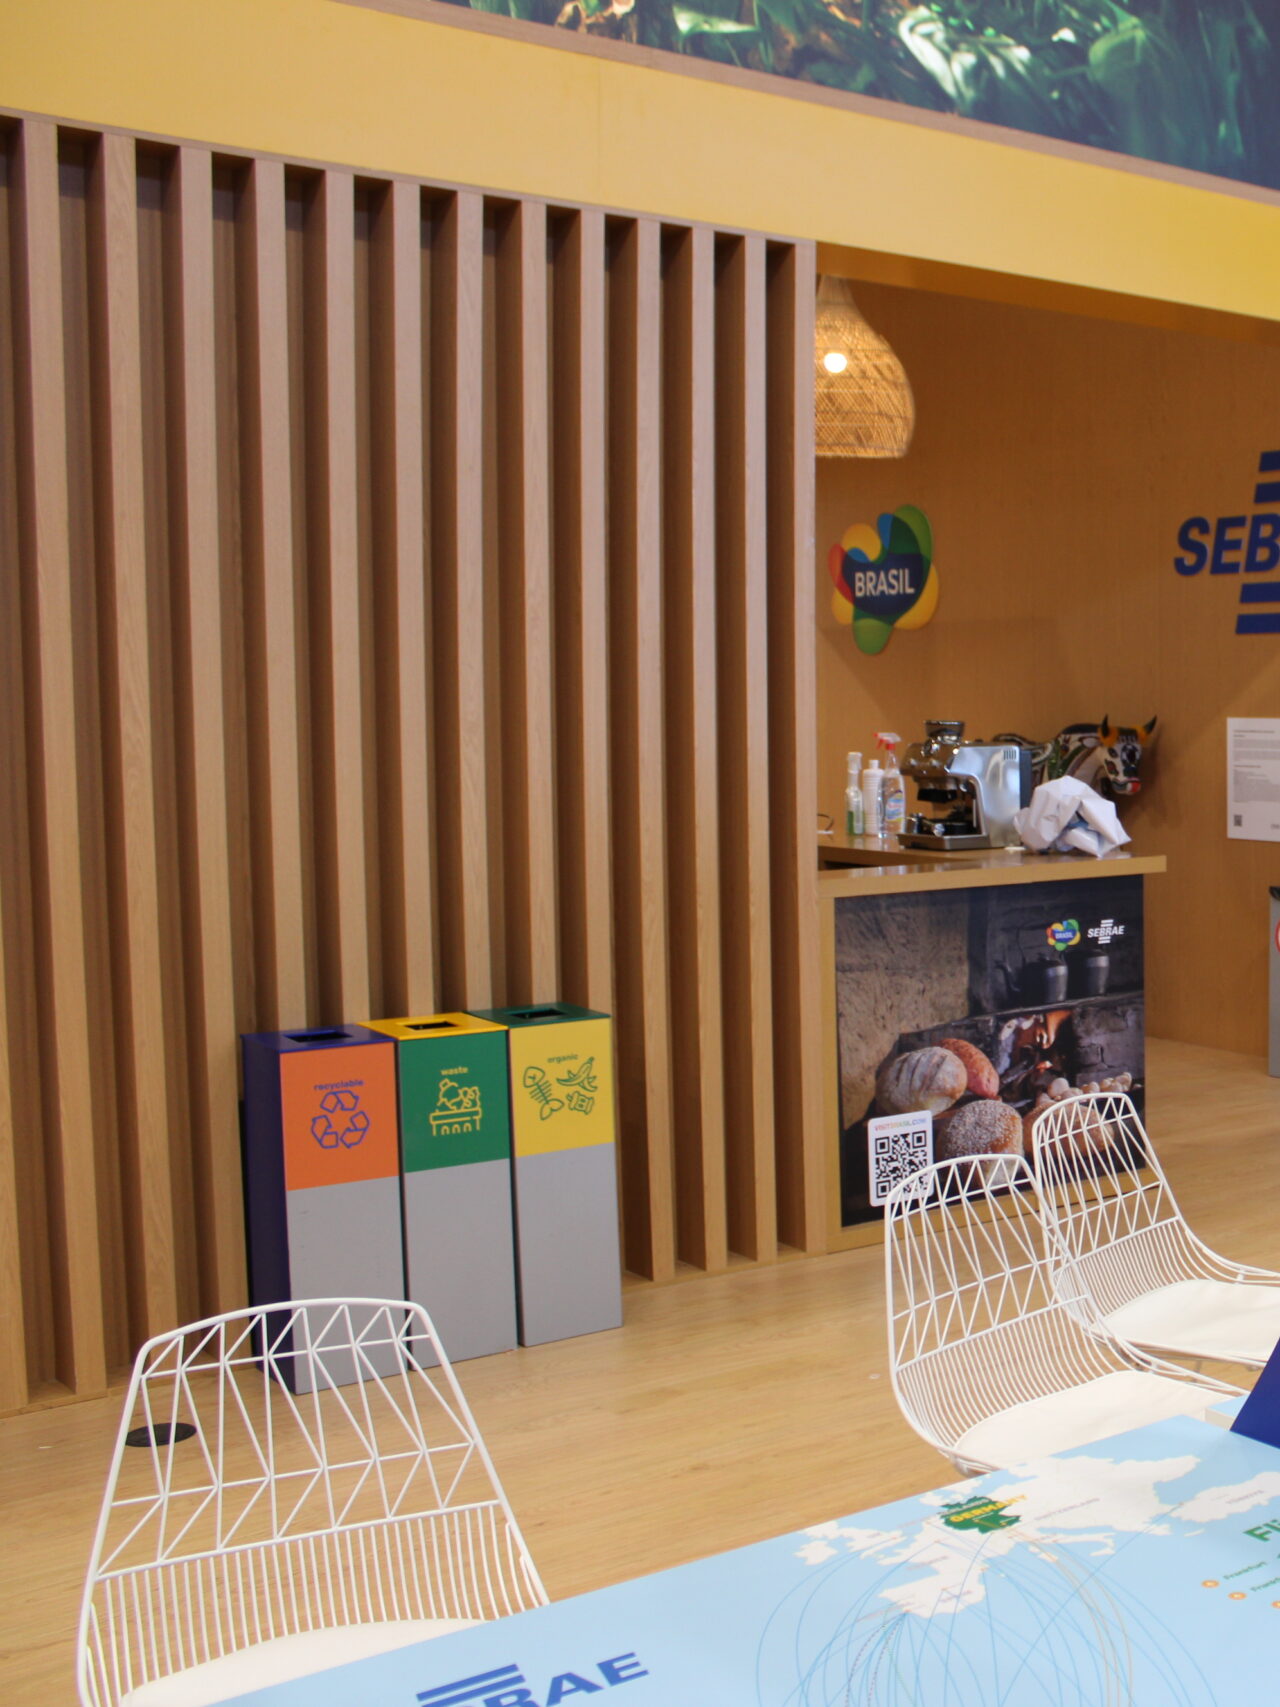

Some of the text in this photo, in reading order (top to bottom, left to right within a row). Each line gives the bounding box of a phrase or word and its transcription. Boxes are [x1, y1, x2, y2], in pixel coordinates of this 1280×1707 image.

[855, 567, 916, 598] BRASIL
[1087, 925, 1125, 938] SEBRAE
[547, 1053, 579, 1064] organic
[441, 1066, 468, 1075] waste
[313, 1079, 364, 1091] recyclable
